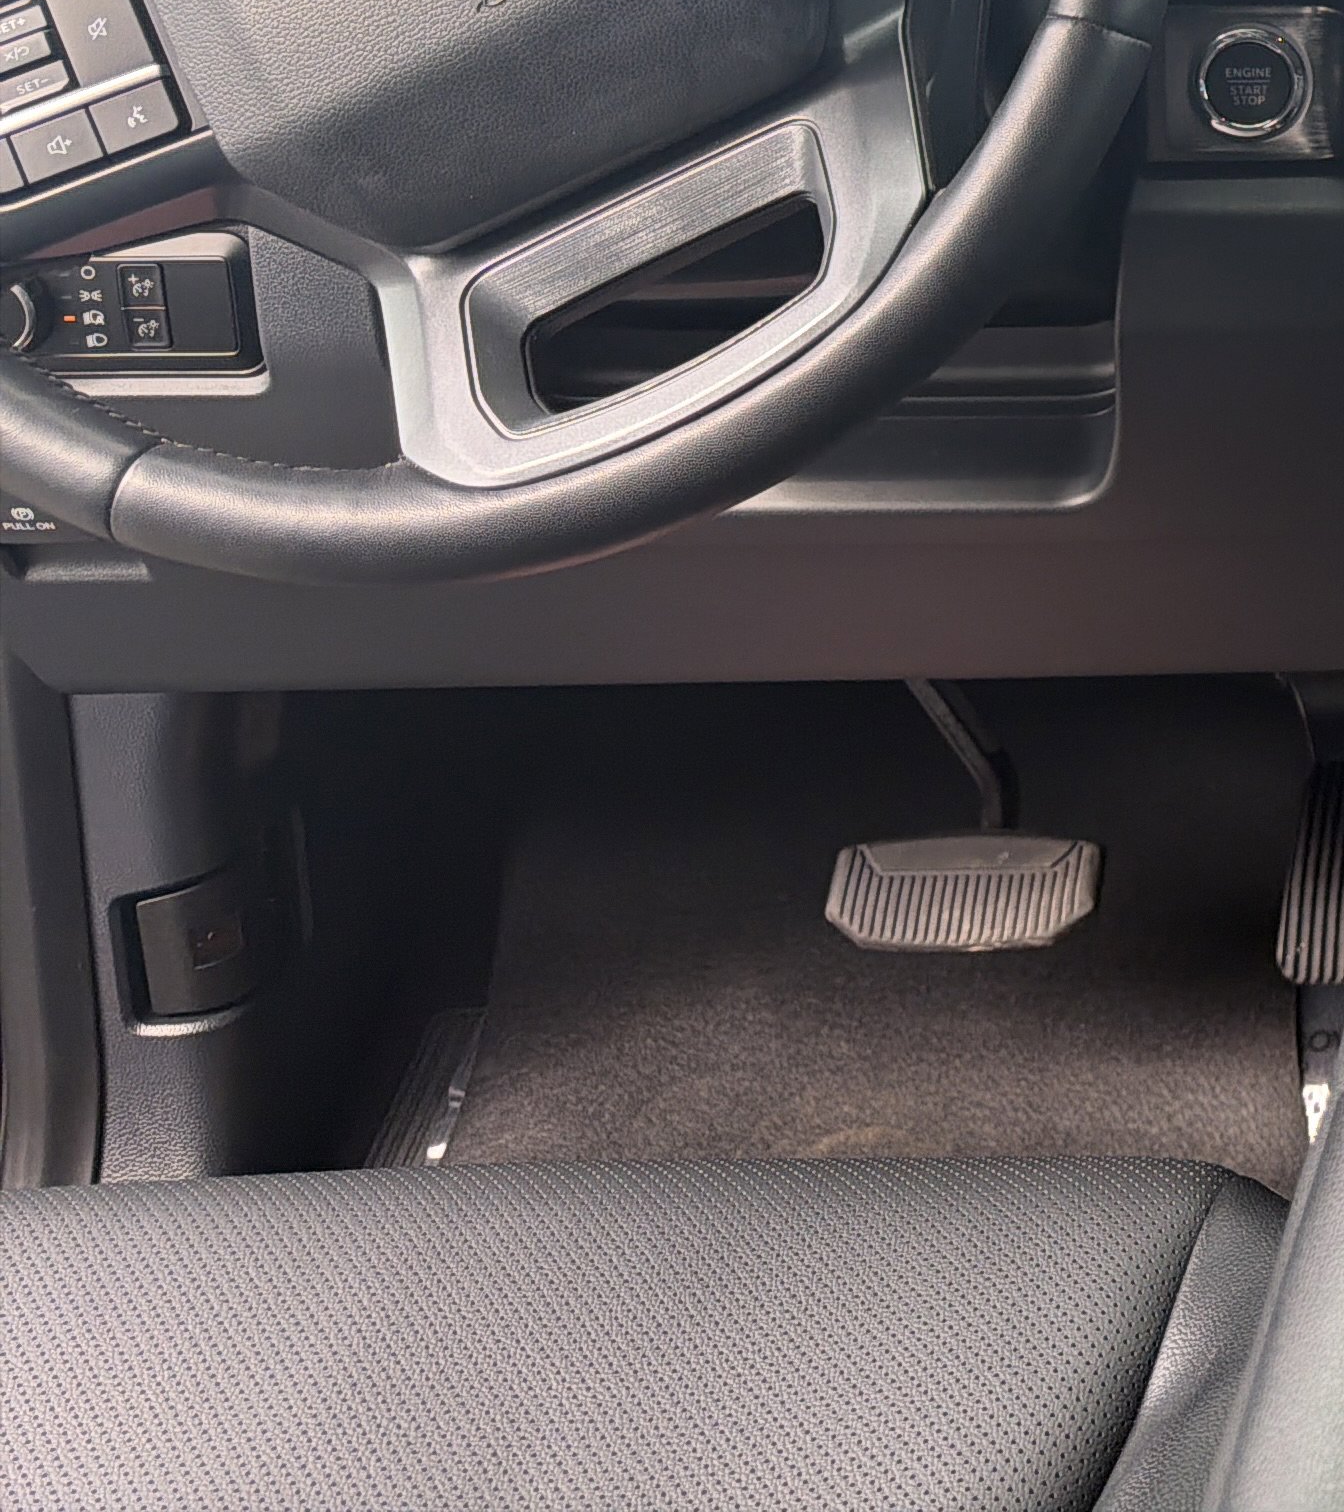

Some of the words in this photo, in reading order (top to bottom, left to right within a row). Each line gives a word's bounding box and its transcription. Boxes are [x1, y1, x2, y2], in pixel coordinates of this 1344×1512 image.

[1225, 67, 1273, 78] ENGINE
[1229, 85, 1268, 96] START
[1233, 95, 1266, 106] STOP
[2, 522, 36, 530] PULL
[36, 521, 56, 530] ON
